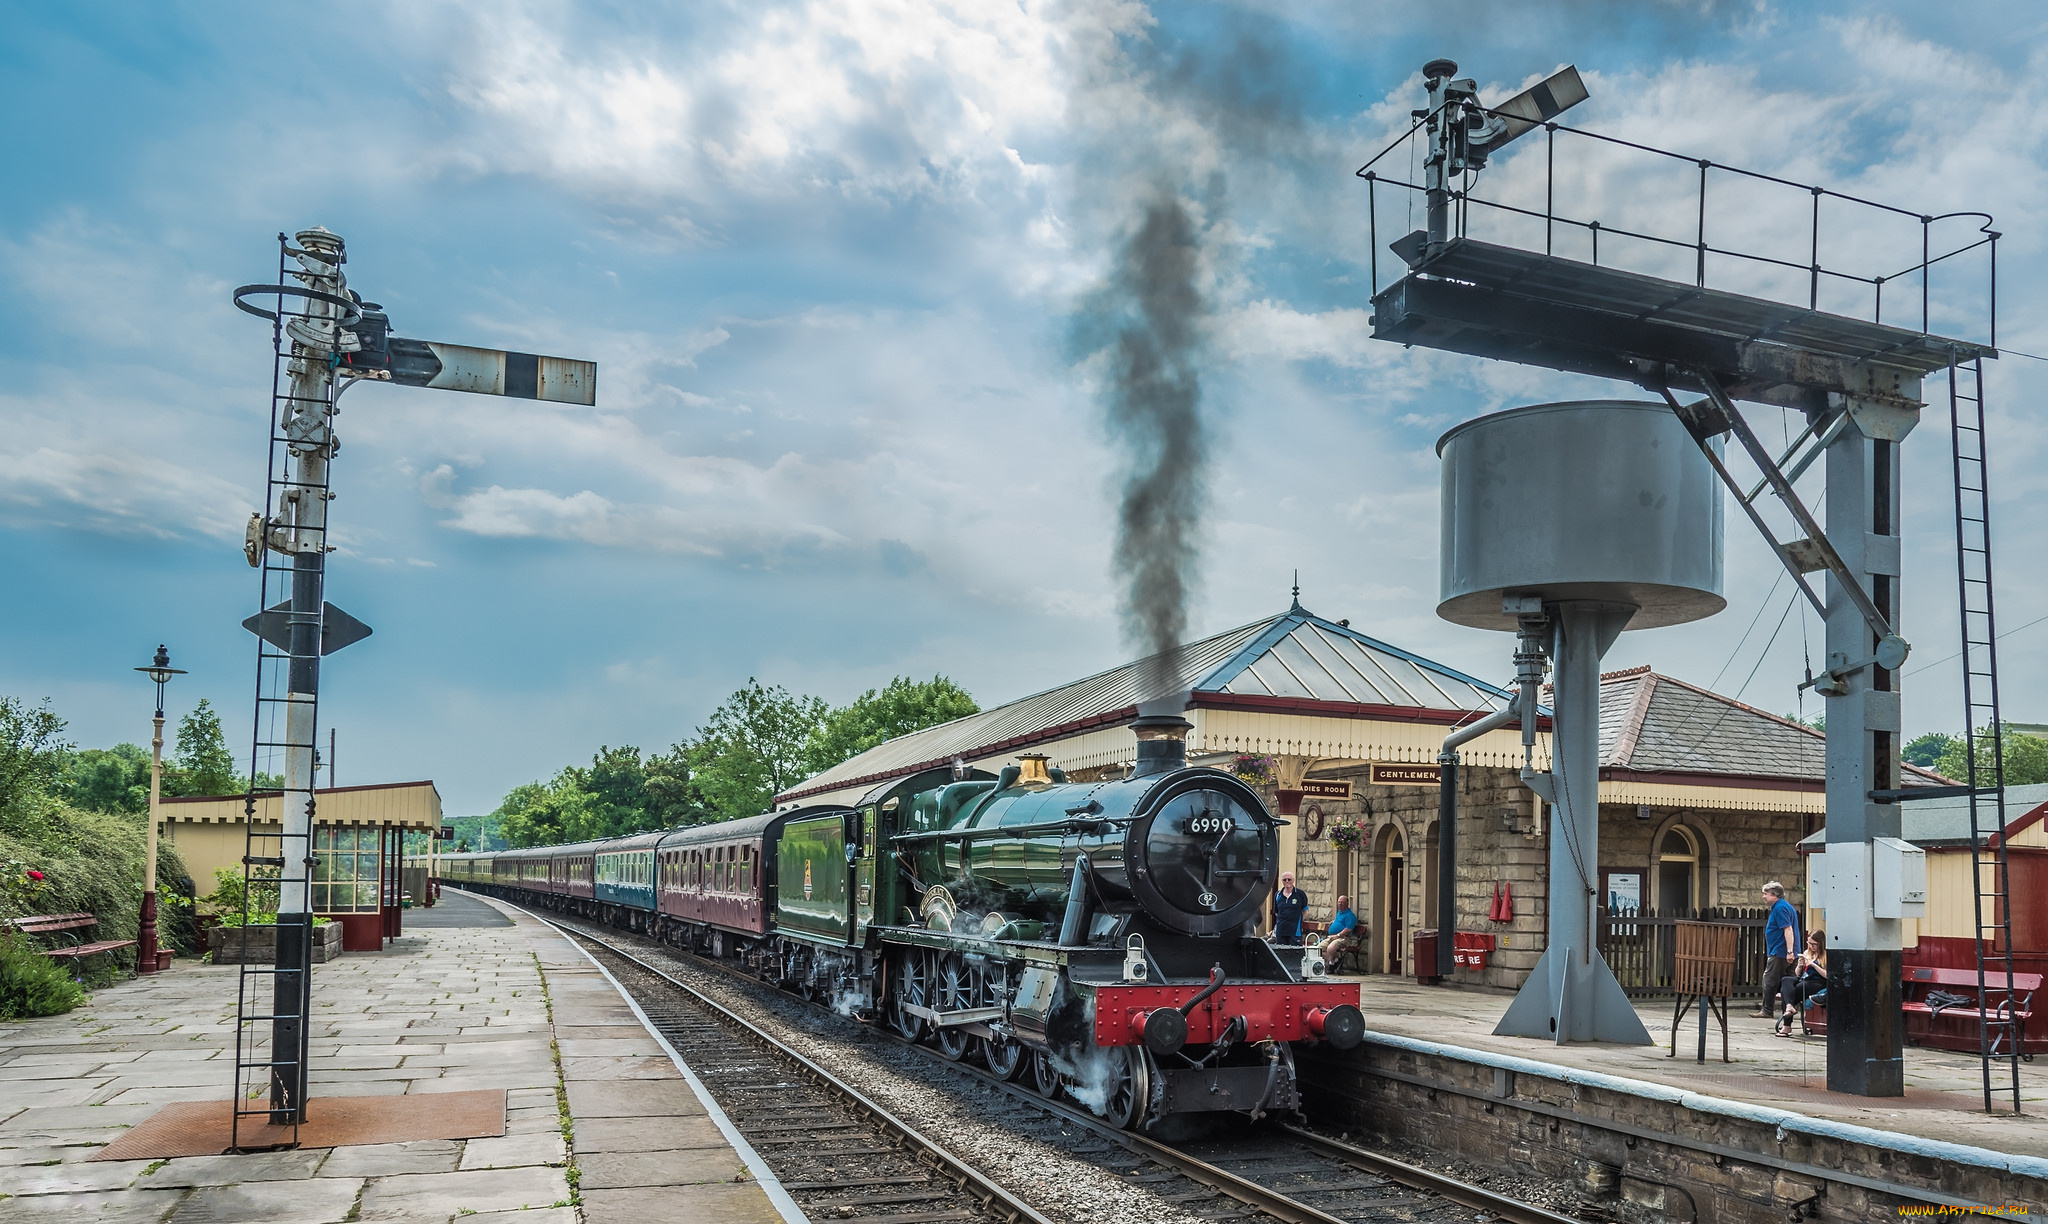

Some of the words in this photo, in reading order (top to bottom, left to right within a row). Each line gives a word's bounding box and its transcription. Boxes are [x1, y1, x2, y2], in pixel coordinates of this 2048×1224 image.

[1380, 771, 1436, 779] GENTLEMEN
[1300, 785, 1321, 793] ADIES
[1324, 786, 1345, 794] ROOM
[1191, 818, 1231, 832] 6990
[1454, 954, 1465, 963] RE
[1468, 955, 1481, 965] RE
